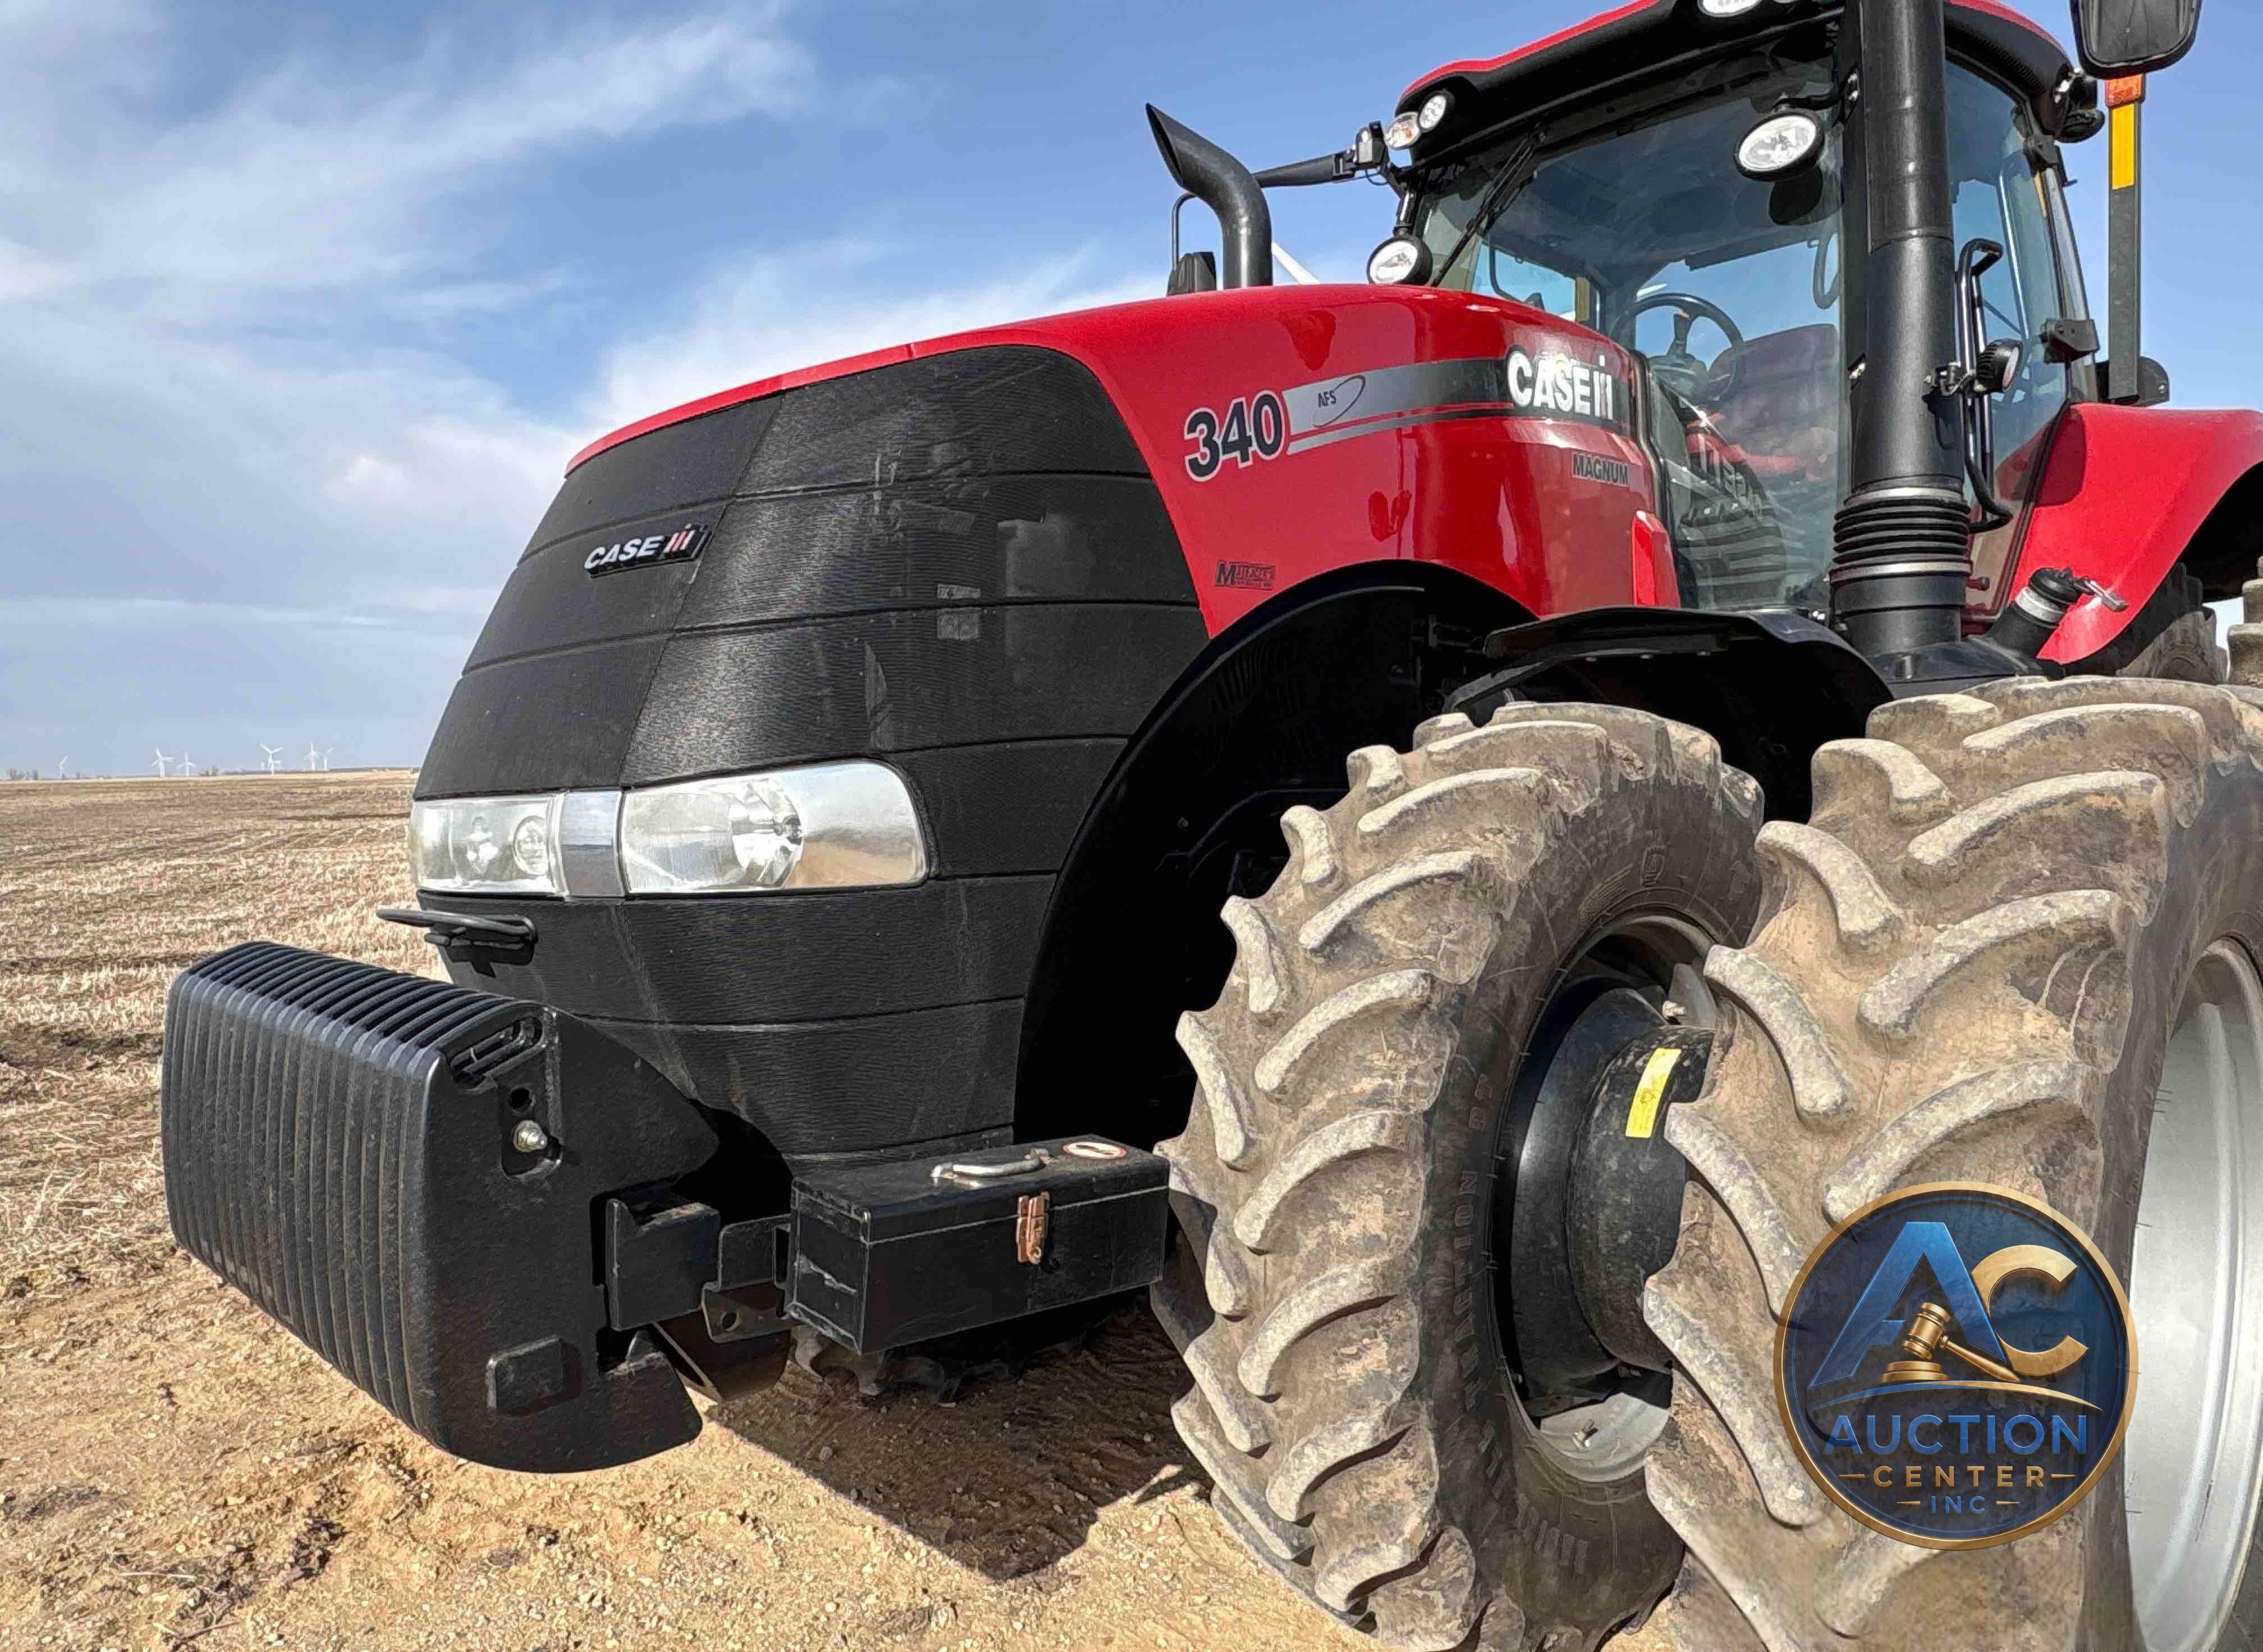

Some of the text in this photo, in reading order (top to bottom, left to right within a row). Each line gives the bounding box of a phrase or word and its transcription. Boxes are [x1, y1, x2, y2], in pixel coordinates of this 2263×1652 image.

[1318, 389, 1336, 408] AFS
[1507, 350, 1591, 415] CASE
[1184, 391, 1284, 481] 340
[1573, 453, 1628, 485] MAGNUM
[584, 535, 664, 570] CASE
